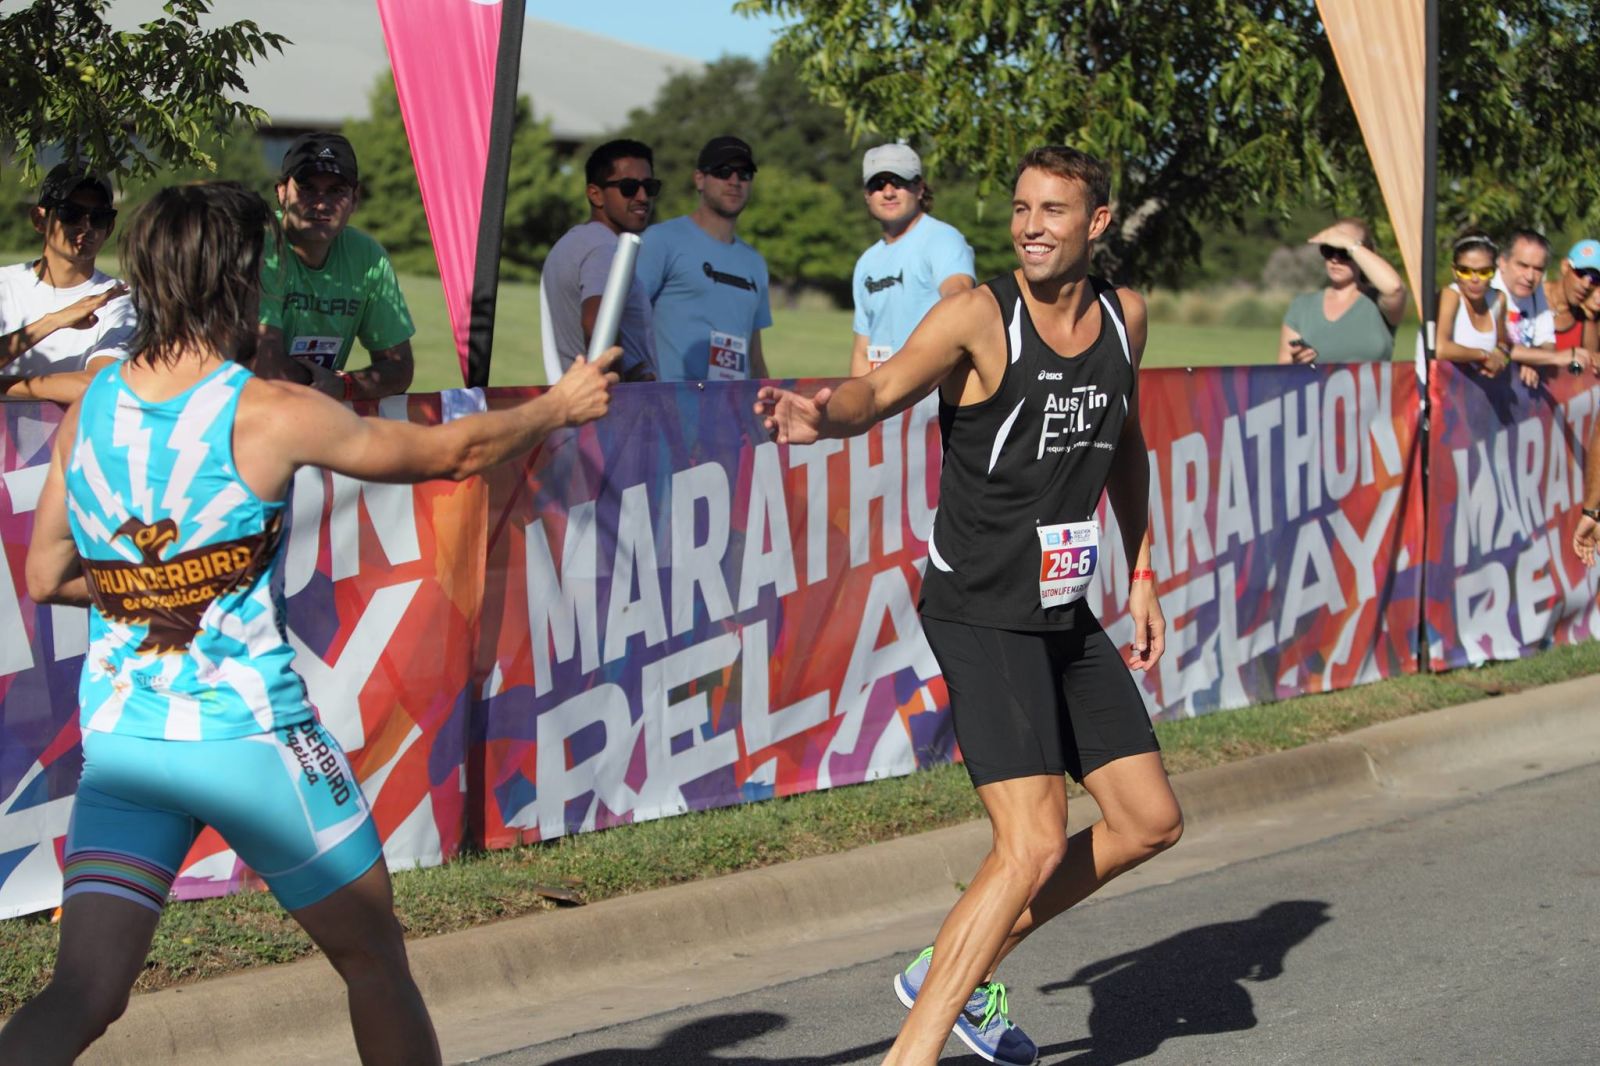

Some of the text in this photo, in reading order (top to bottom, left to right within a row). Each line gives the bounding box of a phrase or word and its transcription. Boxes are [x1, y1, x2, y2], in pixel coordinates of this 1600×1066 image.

[525, 387, 941, 698] MARATHO
[1452, 385, 1600, 568] MARAT
[91, 546, 251, 594] THUNDERBIRD
[1047, 549, 1091, 578] 29-6
[299, 720, 350, 807] DERBIRD
[535, 561, 942, 836] RELA
